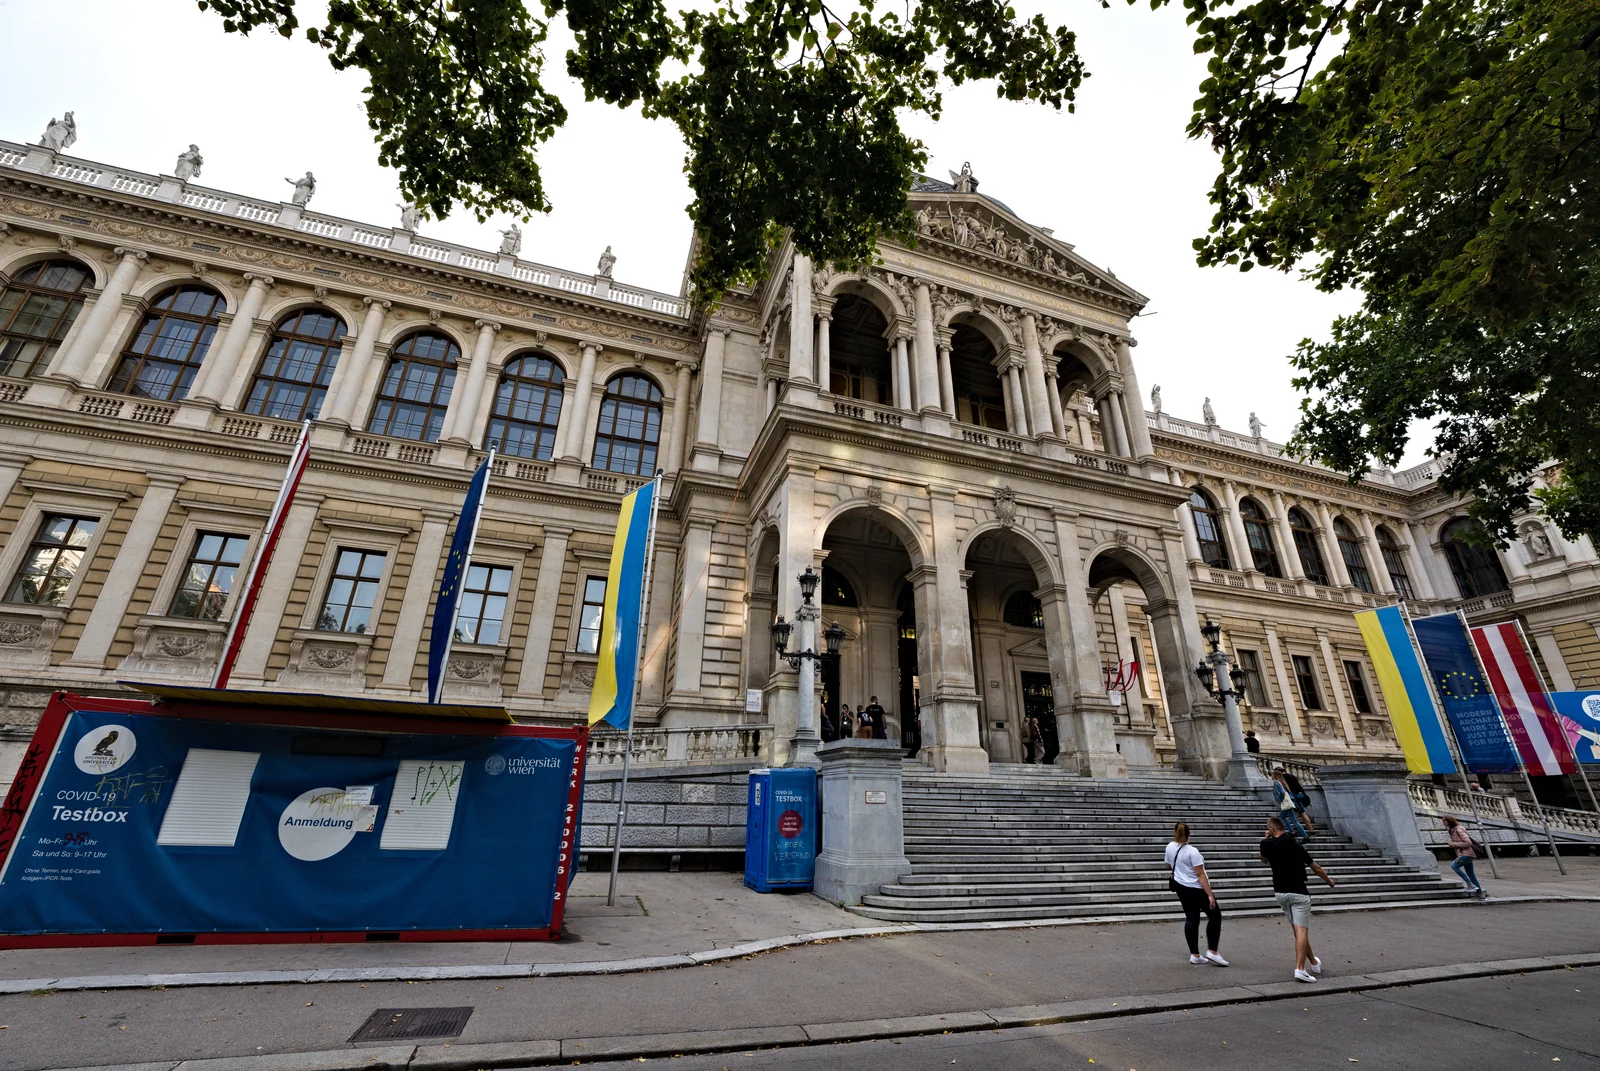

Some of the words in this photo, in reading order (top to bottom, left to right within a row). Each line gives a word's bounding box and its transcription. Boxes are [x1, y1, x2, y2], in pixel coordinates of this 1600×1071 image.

[1456, 709, 1493, 719] MODERN
[1462, 724, 1488, 733] MORE
[1466, 731, 1487, 740] JUST
[1489, 727, 1526, 737] DIGGNG
[1469, 739, 1486, 747] FOR
[508, 756, 561, 768] universität
[508, 766, 535, 775] wien
[57, 790, 116, 802] COVID-19
[775, 795, 803, 803] TESTBOX
[52, 805, 129, 823] Testbox
[284, 816, 354, 830] Anmeldung
[557, 803, 574, 875] 210006
